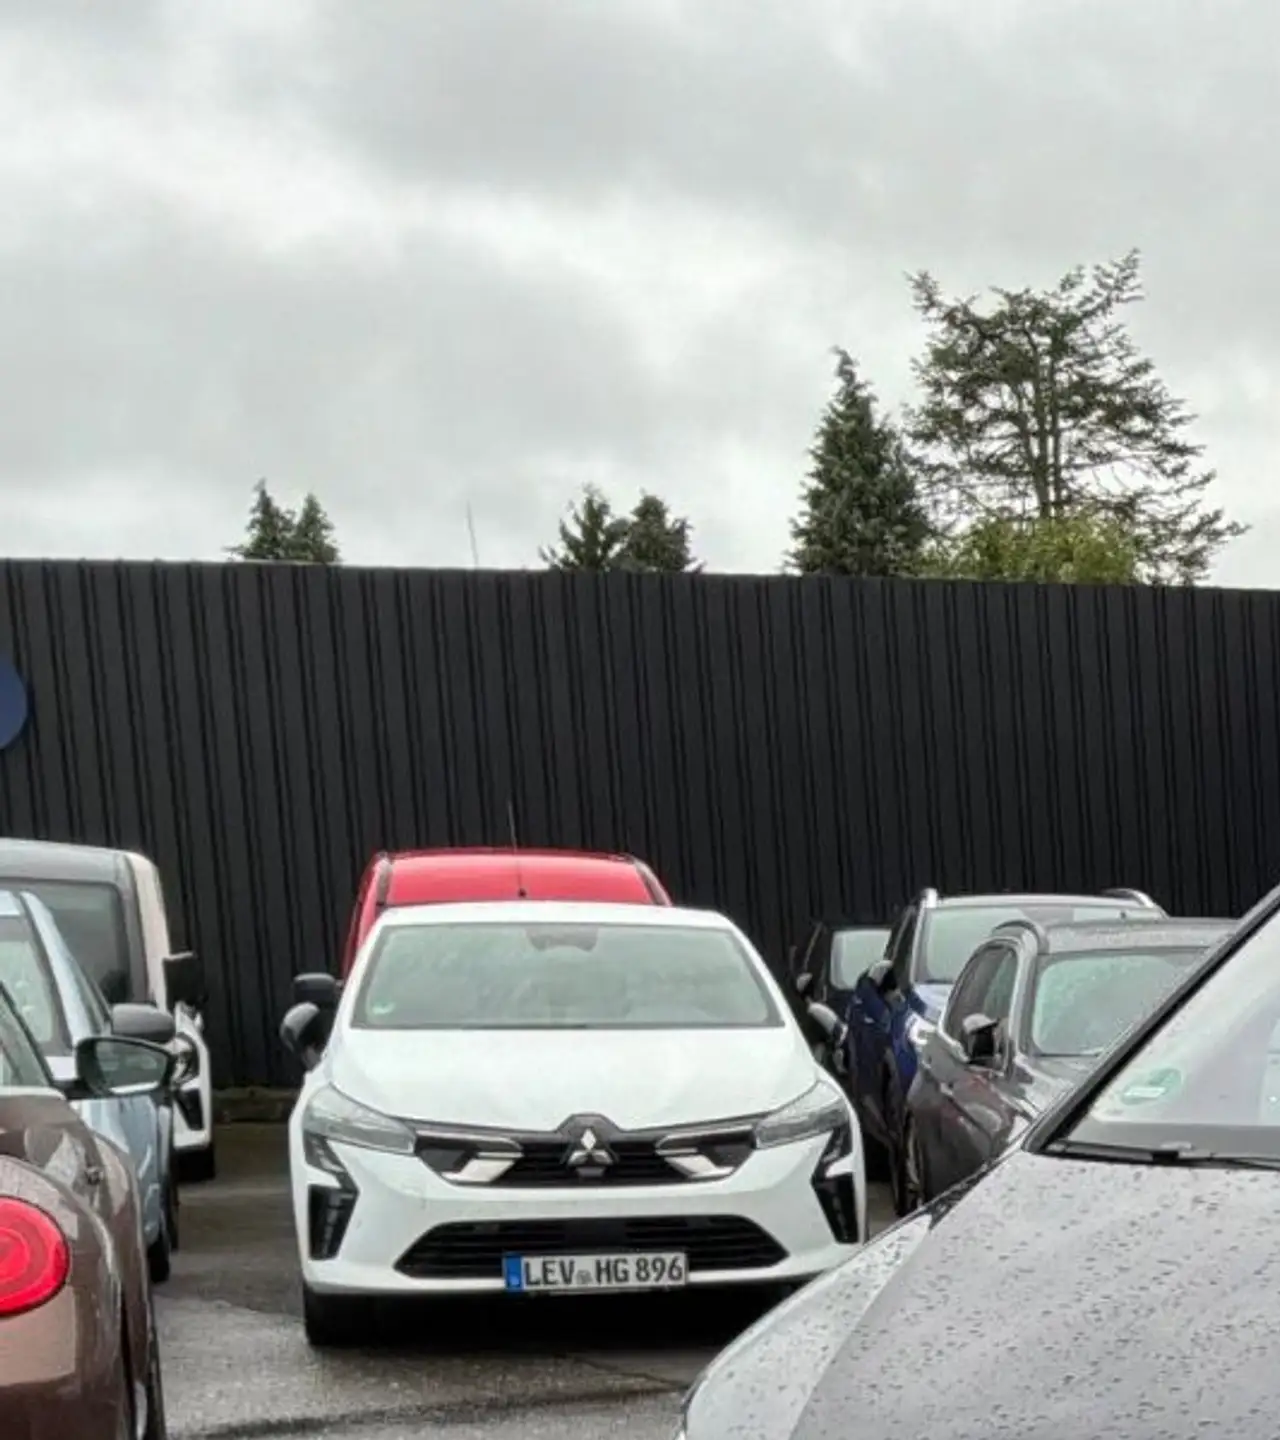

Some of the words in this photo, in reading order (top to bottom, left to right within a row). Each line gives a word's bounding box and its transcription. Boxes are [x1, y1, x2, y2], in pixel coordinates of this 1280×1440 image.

[525, 1259, 575, 1286] LEV
[595, 1258, 630, 1284] HG
[636, 1256, 684, 1283] 896
